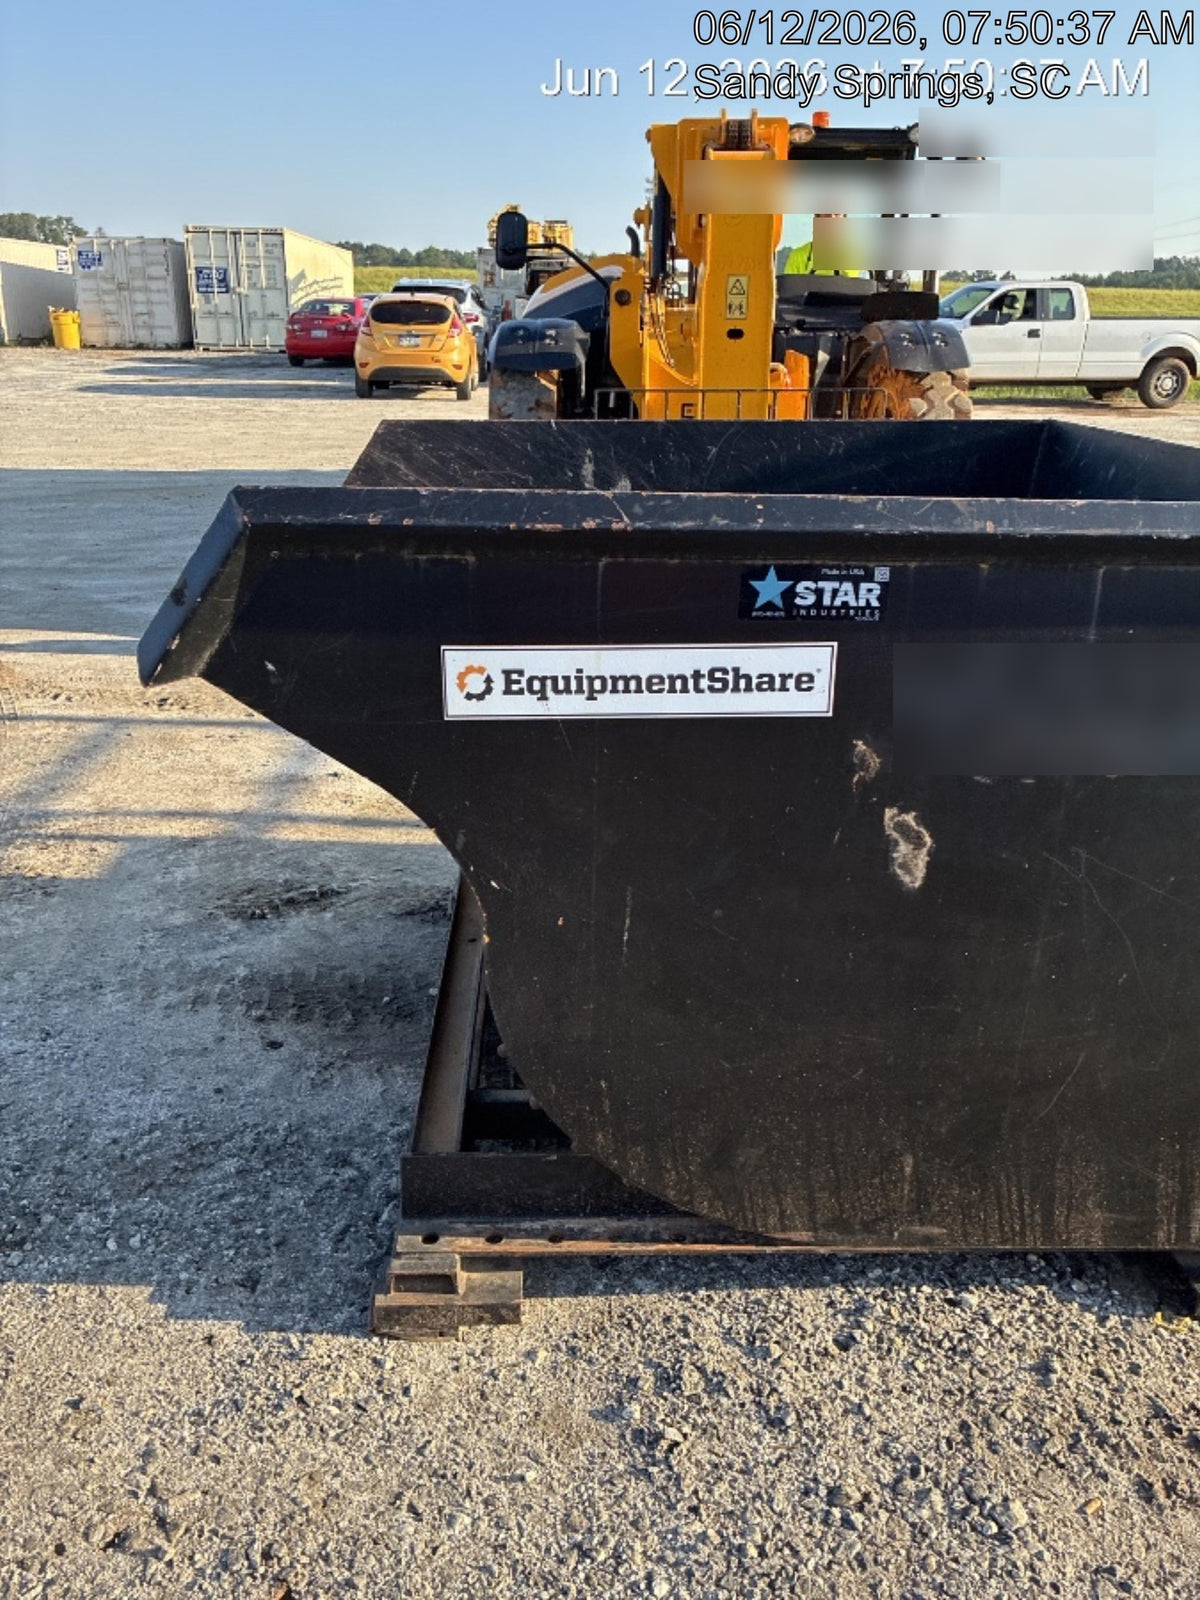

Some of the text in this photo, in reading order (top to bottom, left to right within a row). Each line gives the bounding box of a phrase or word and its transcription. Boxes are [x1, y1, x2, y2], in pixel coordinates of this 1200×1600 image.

[794, 580, 881, 608] STAR
[792, 608, 880, 617] INDUSTRIES
[501, 667, 815, 702] EquipmentShare
